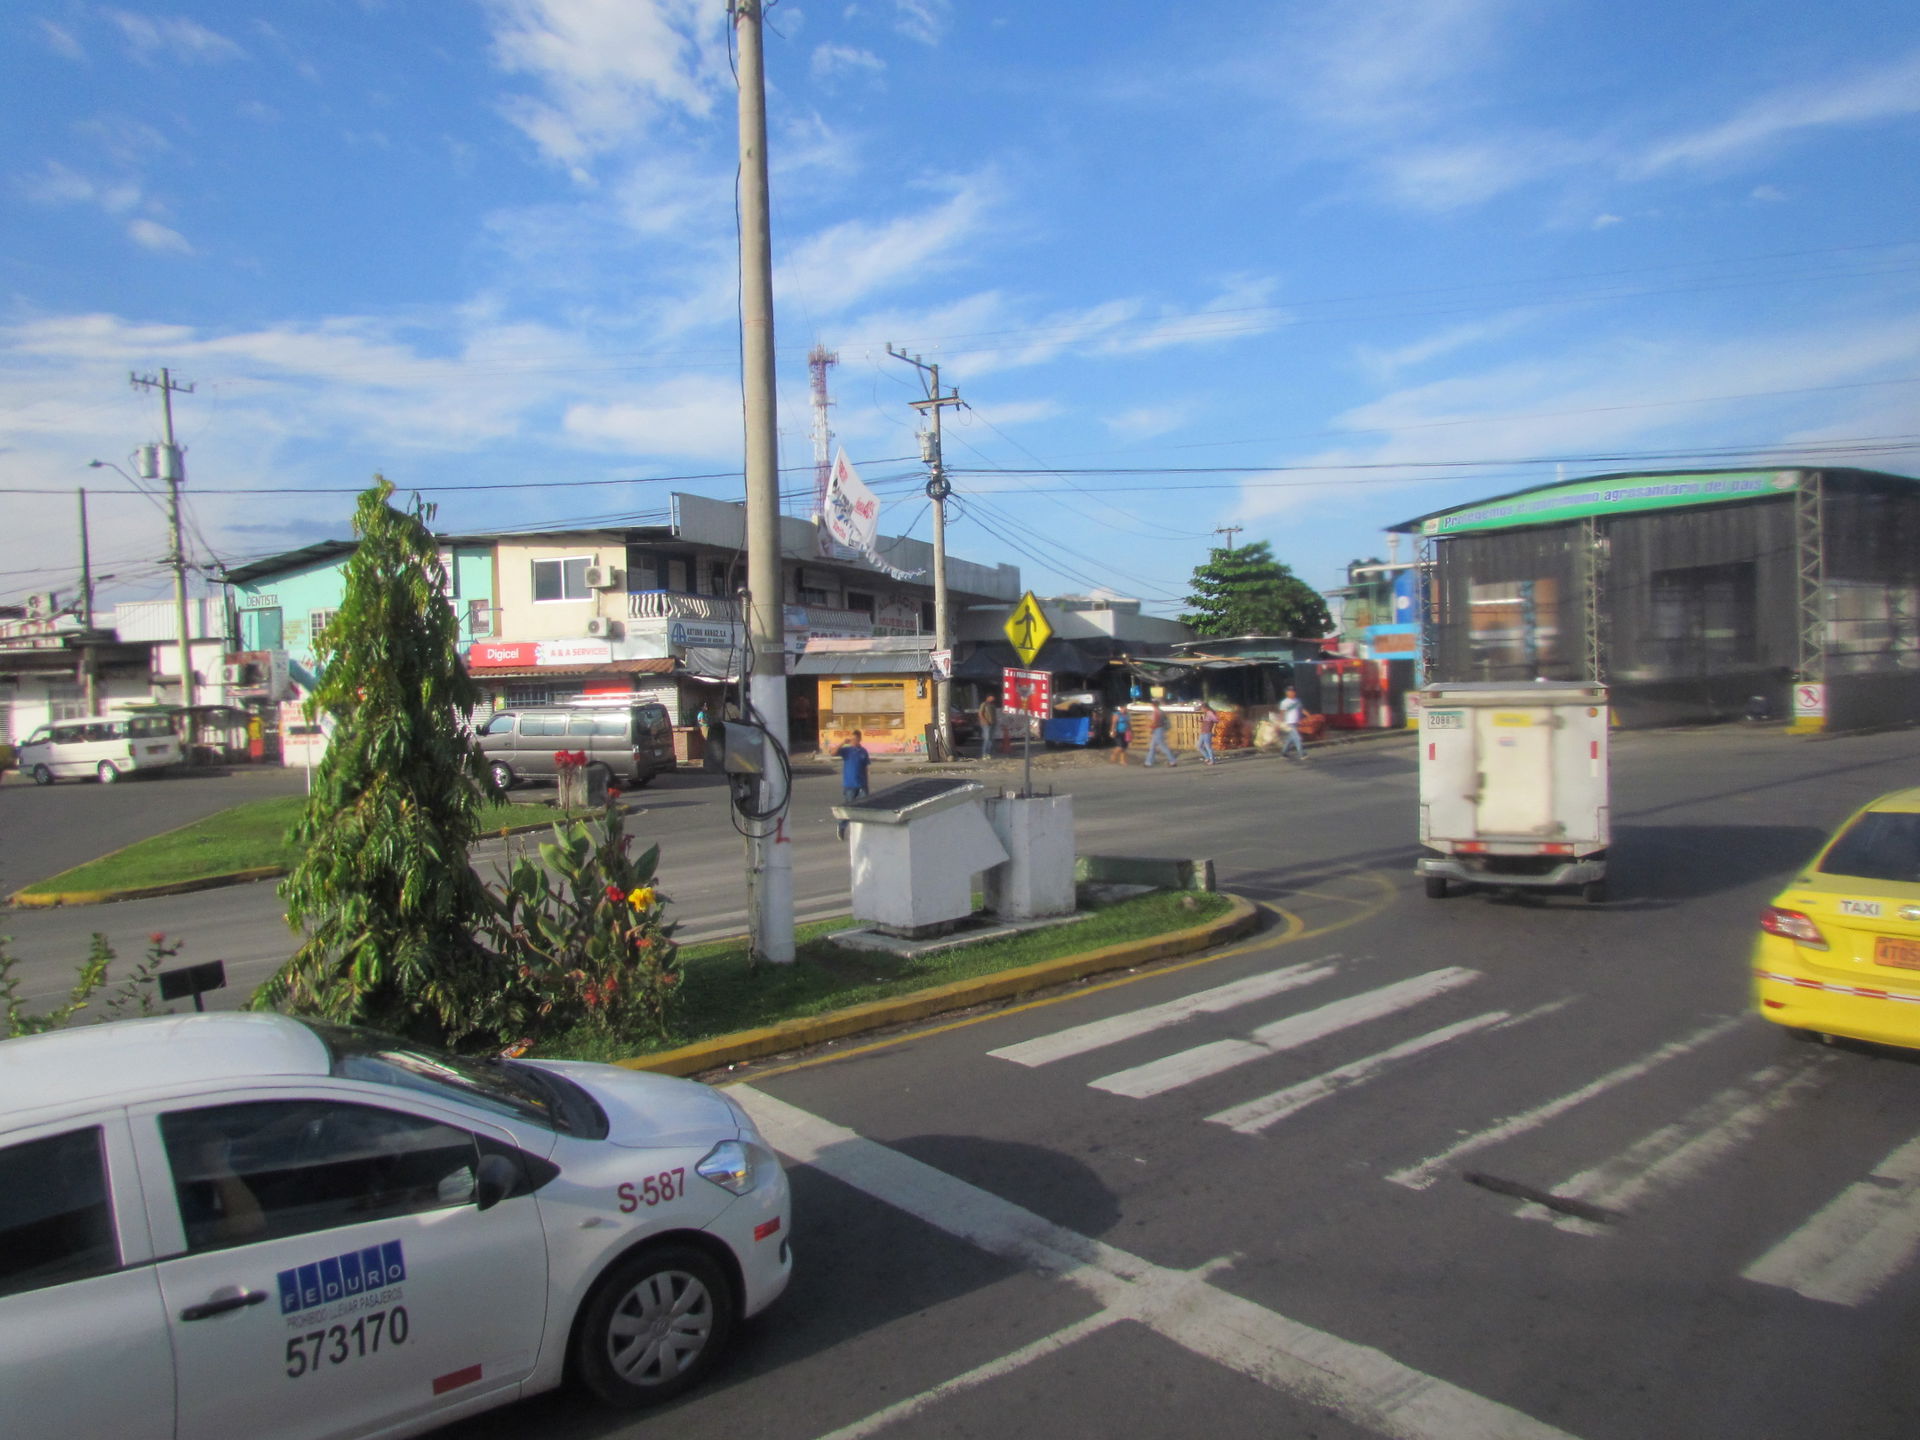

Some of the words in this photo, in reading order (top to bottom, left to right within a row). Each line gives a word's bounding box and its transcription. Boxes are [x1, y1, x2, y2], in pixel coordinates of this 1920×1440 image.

[246, 594, 279, 607] DENTISTA
[487, 648, 519, 662] Digicel
[550, 649, 556, 657] A
[566, 649, 571, 657] A
[572, 647, 609, 657] SERVICES
[1841, 900, 1880, 916] TAXI
[283, 1264, 402, 1309] FEDURO
[359, 1286, 404, 1309] PASAJEROS
[286, 1305, 408, 1378] 573170
